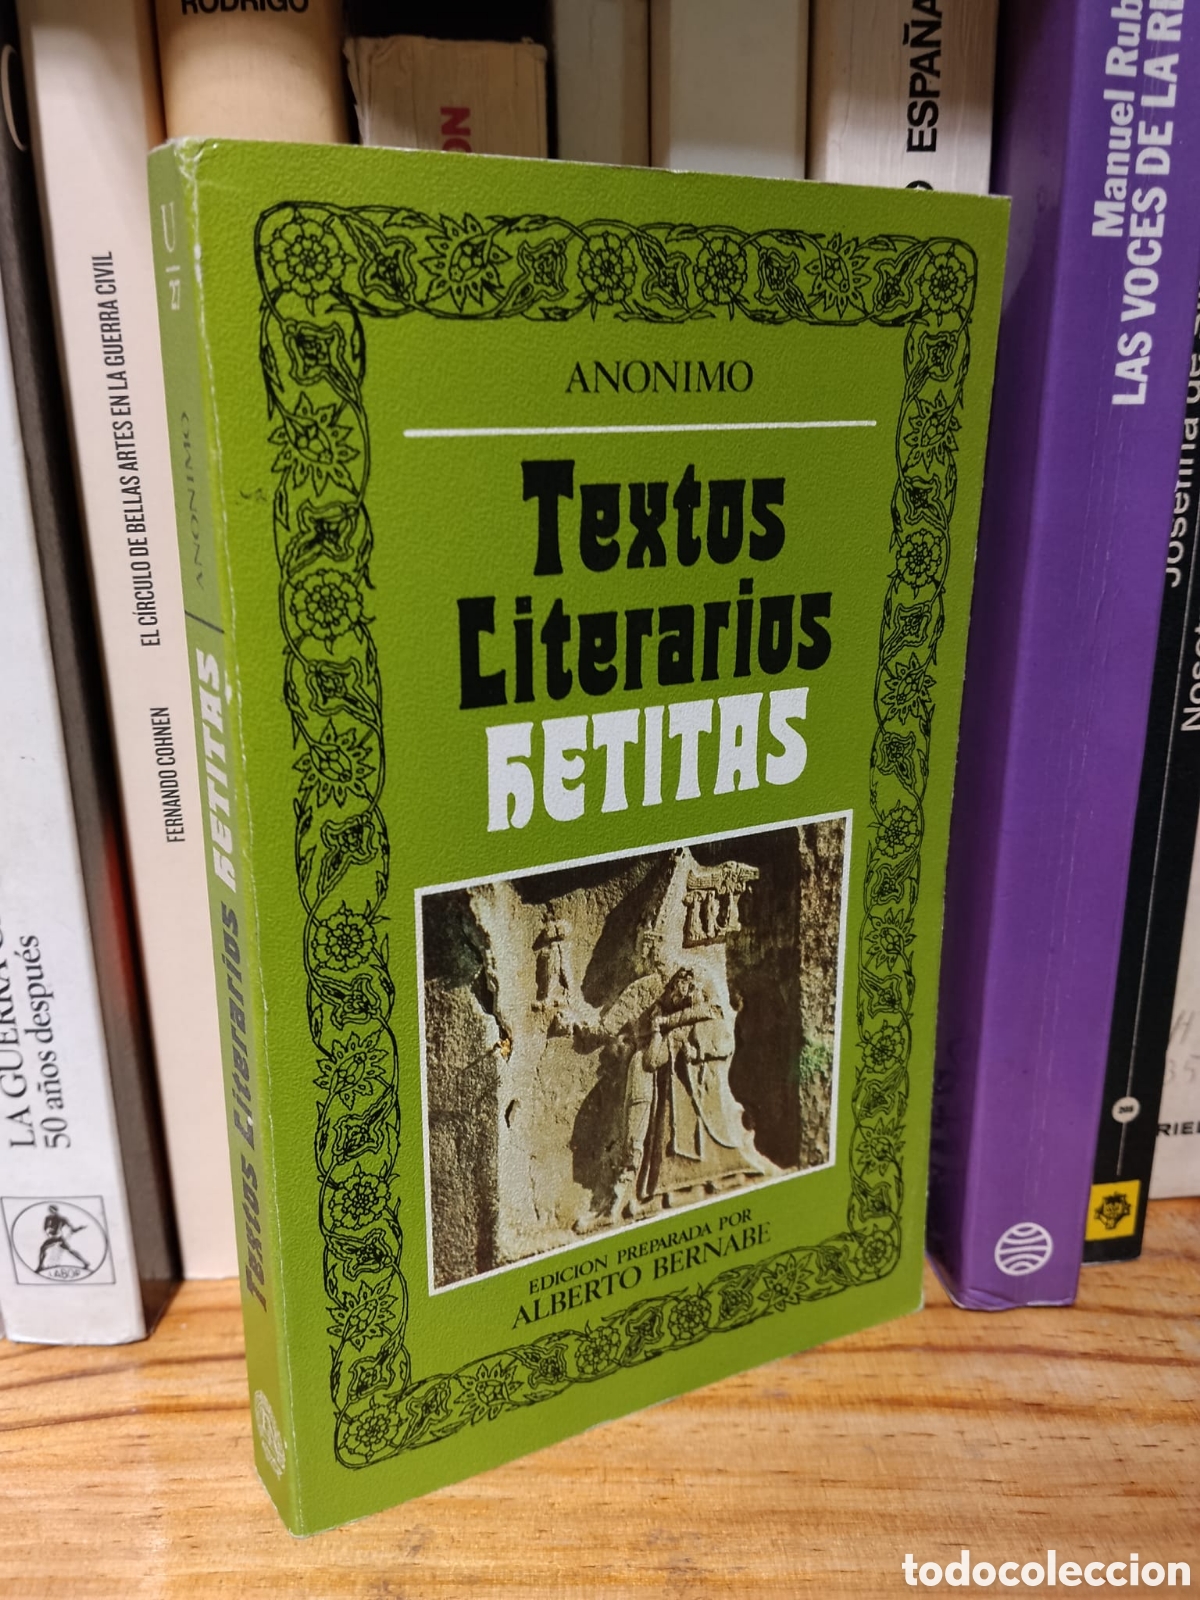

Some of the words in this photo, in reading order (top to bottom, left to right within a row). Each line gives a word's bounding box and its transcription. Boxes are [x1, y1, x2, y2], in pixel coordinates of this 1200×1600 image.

[181, 0, 309, 15] RODRIGO
[903, 0, 943, 152] ESPAÑA
[1141, 54, 1180, 107] LA
[1092, 90, 1135, 237] Manuel
[1135, 121, 1174, 175] DE
[92, 251, 117, 295] CIVIL
[1120, 187, 1168, 322] VOCES
[98, 300, 125, 366] GUERRA
[106, 371, 128, 390] LA
[565, 359, 754, 394] ANONIMO
[1112, 332, 1153, 405] LAS
[109, 395, 131, 415] EN
[112, 420, 139, 471] ARTES
[119, 476, 146, 533] BELLAS
[521, 458, 786, 576] Textos
[127, 537, 149, 556] DE
[131, 561, 158, 628] CÍRCULO
[140, 629, 161, 646] EL
[457, 577, 833, 710] Literarios
[150, 707, 176, 766] COHNEN
[158, 770, 185, 843] FERNANDO
[14, 935, 54, 1045] después
[221, 901, 256, 1150] Literarios
[38, 1050, 64, 1110] años
[6, 1105, 37, 1149] LA
[44, 1116, 71, 1149] 50
[1158, 1121, 1200, 1137] RIE
[241, 1154, 268, 1313] Textos
[529, 1255, 609, 1294] EDICION
[617, 1222, 713, 1265] PREPARADA
[719, 1208, 752, 1231] POR
[512, 1265, 641, 1329] ALBERTO
[653, 1221, 771, 1280] BERNABE
